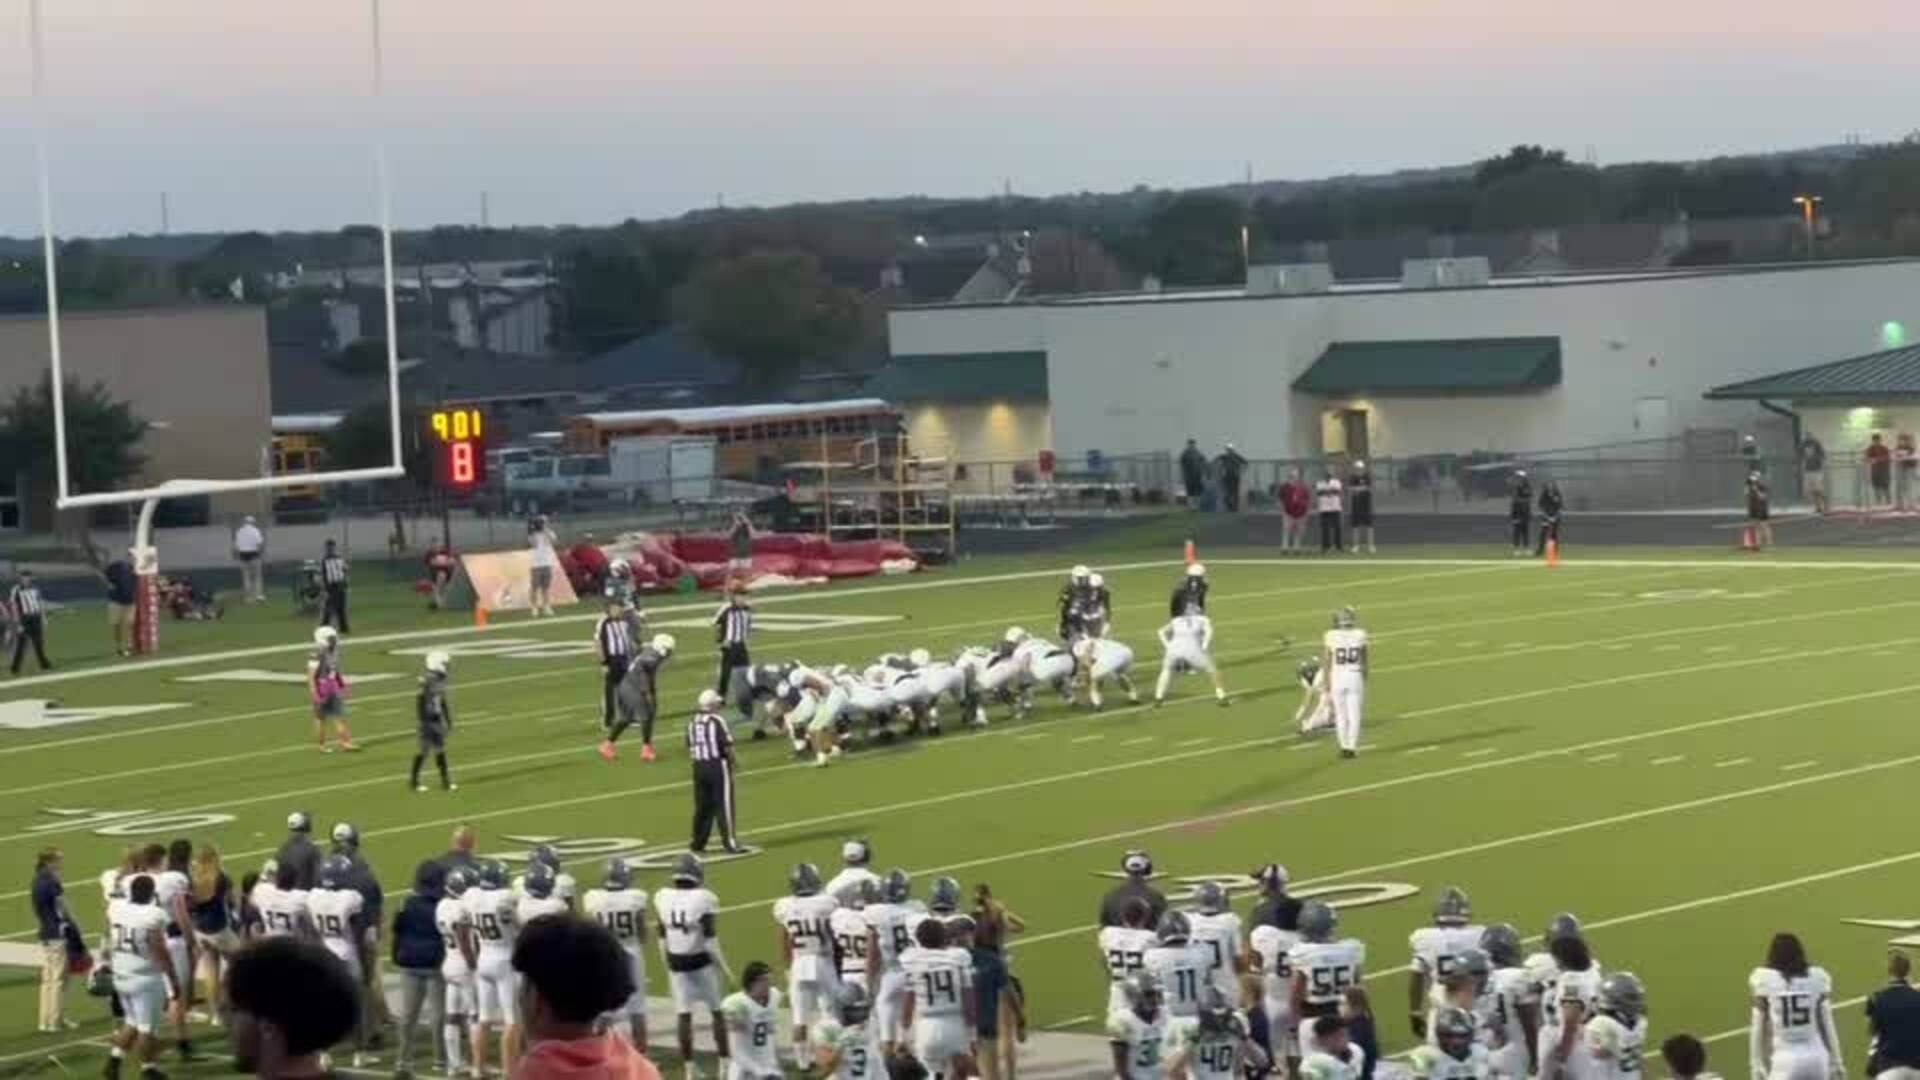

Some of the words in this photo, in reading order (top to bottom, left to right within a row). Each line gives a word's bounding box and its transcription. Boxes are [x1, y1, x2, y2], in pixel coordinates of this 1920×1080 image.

[453, 443, 474, 482] 8
[671, 909, 689, 934] 4
[922, 969, 956, 1005] 14
[1175, 968, 1197, 1002] 11
[1779, 993, 1810, 1028] 15
[753, 1021, 768, 1047] 8
[1200, 1044, 1233, 1073] 40
